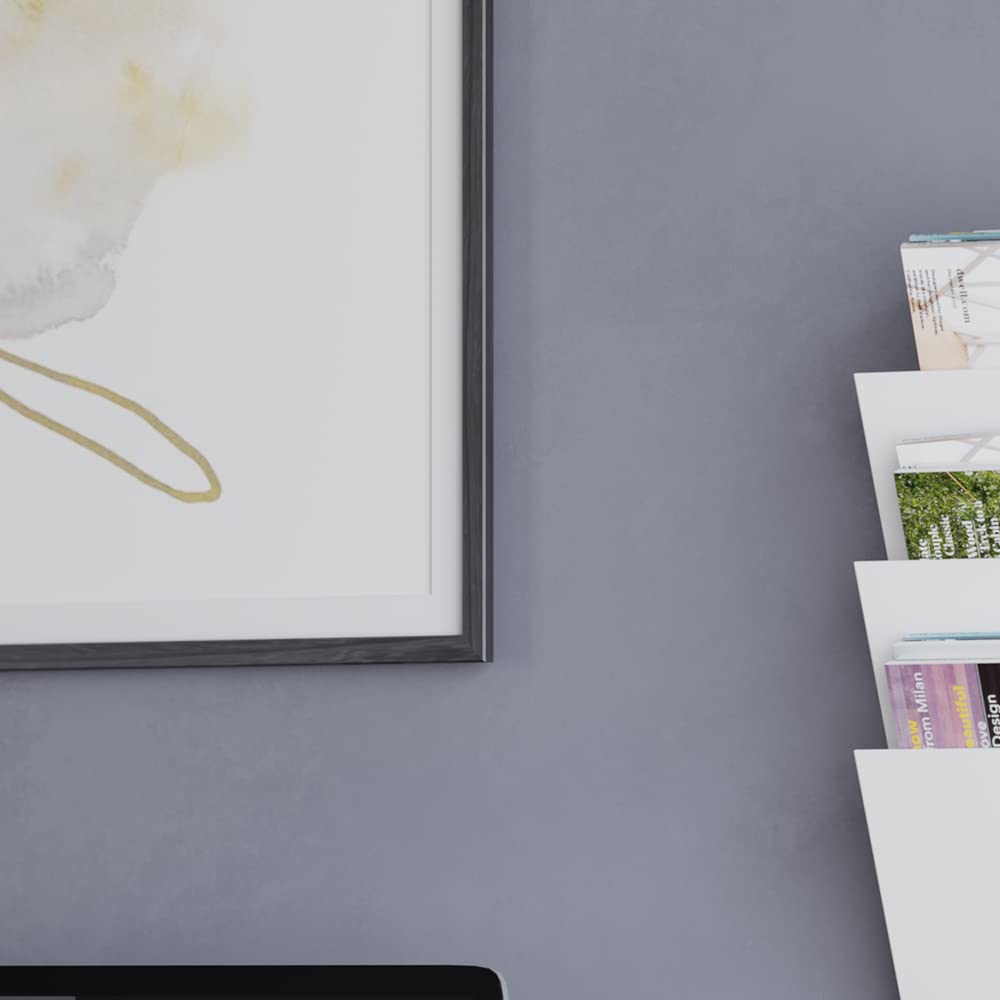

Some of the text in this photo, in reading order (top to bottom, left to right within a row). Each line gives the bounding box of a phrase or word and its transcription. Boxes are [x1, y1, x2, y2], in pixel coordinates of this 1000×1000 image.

[956, 268, 971, 324] dwell.com
[928, 524, 943, 559] ouple
[940, 514, 955, 556] Classic
[913, 672, 929, 713] Milan
